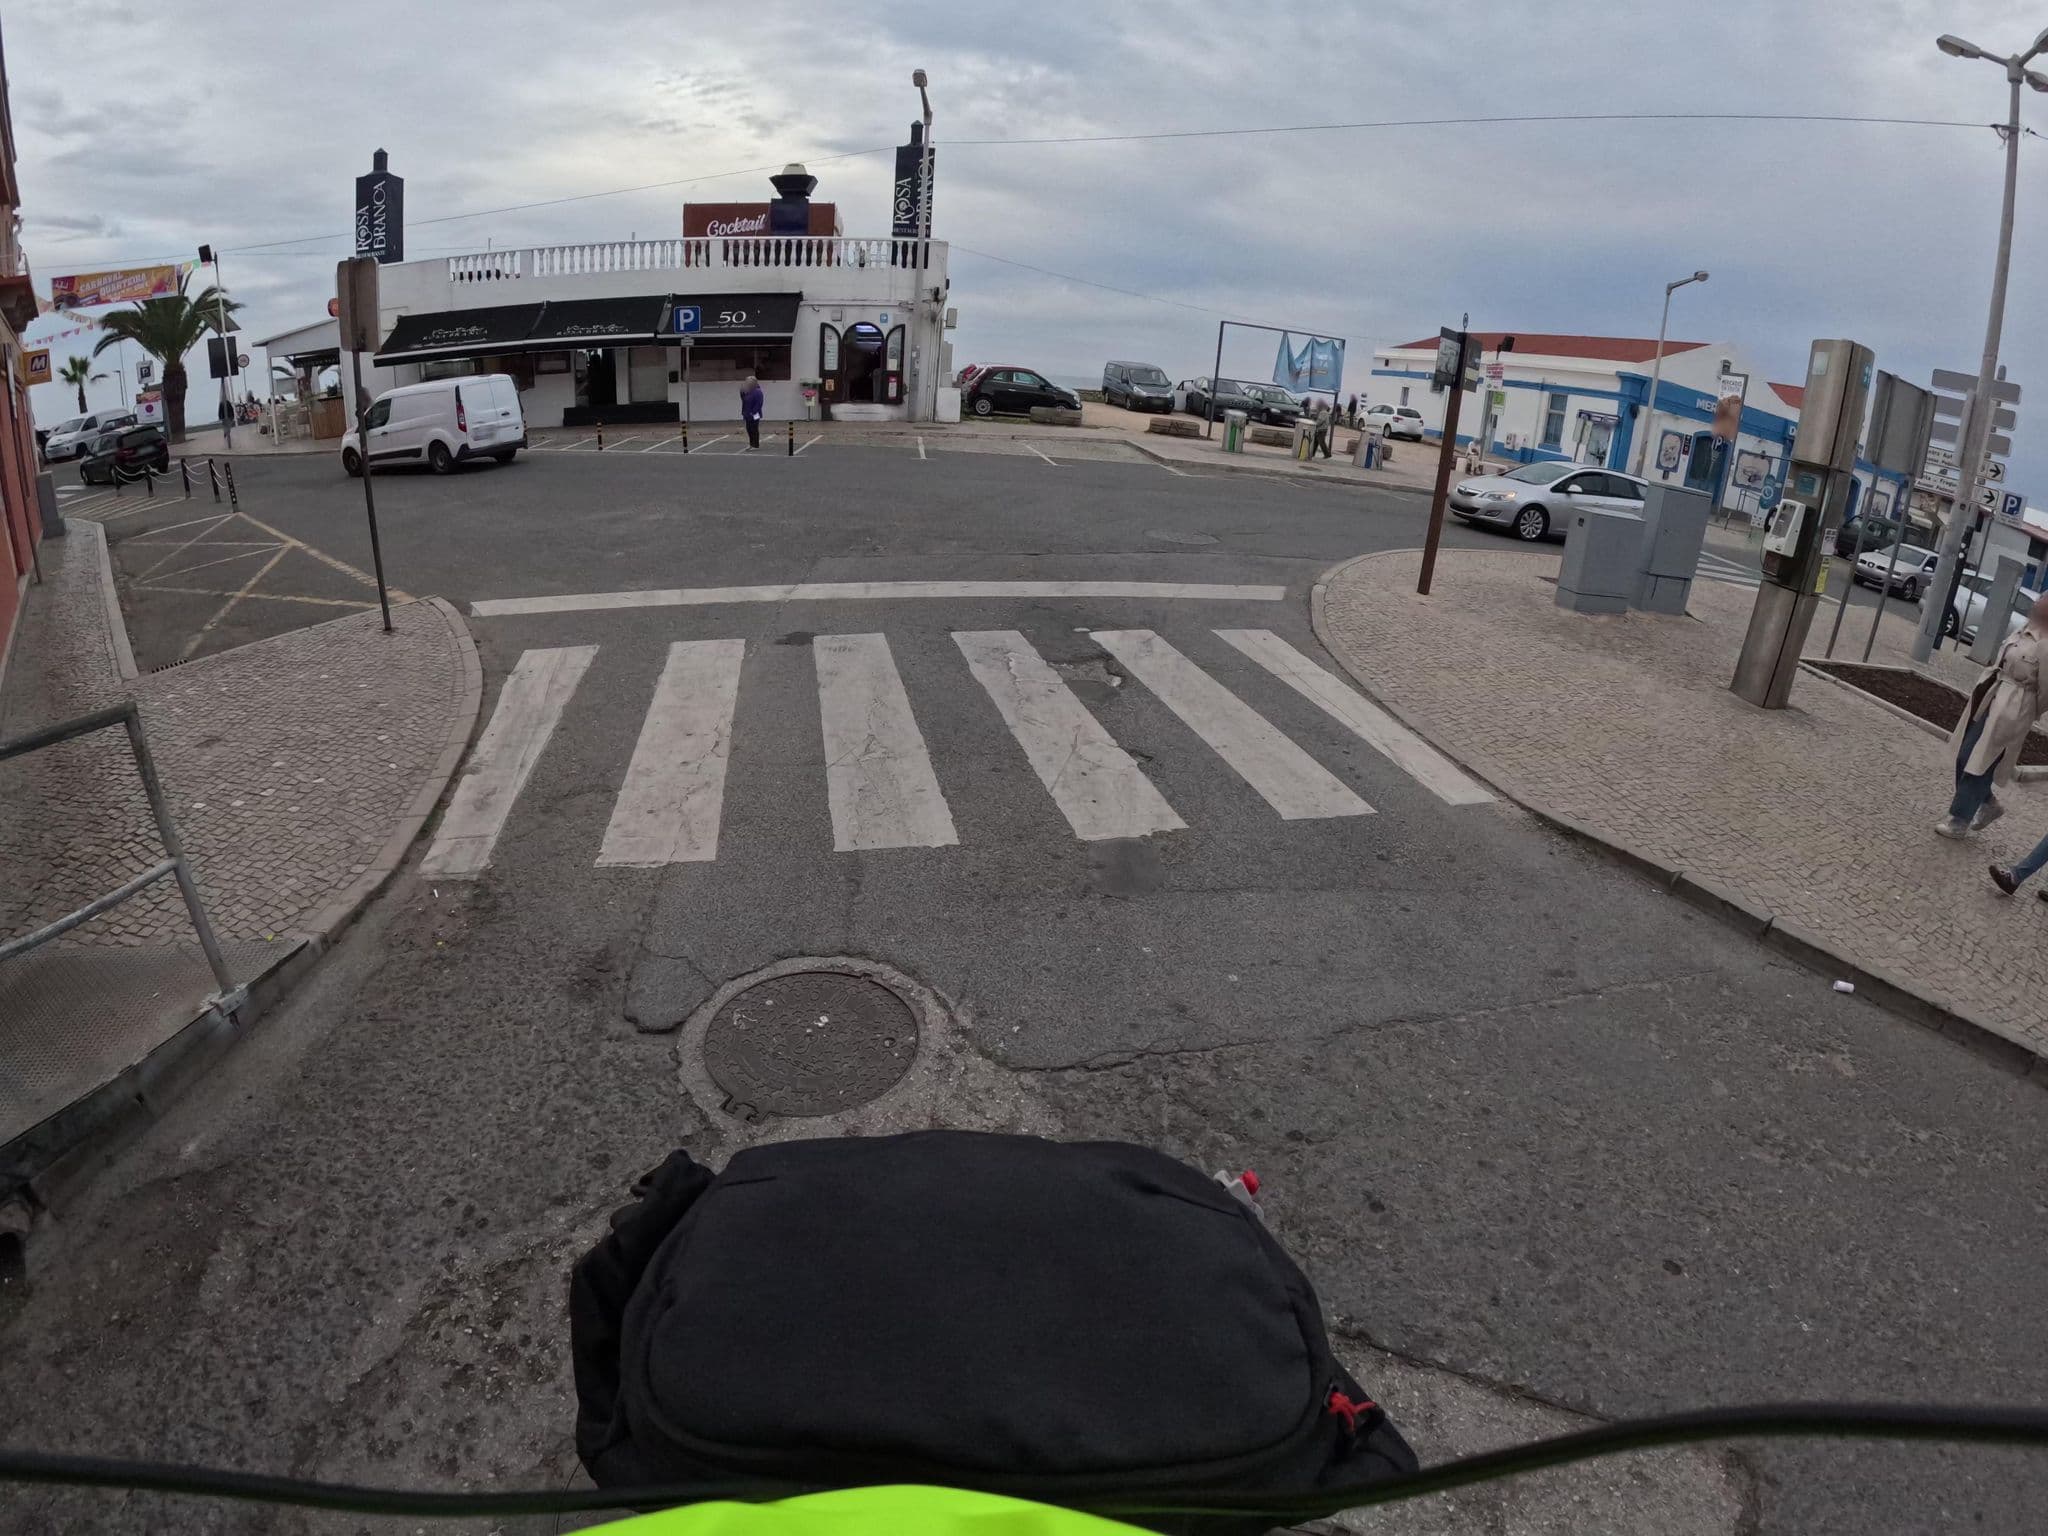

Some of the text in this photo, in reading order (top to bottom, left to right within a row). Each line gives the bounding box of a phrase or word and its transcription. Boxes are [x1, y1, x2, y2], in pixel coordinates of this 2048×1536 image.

[894, 178, 915, 224] ROSA
[373, 180, 386, 248] BRANCA
[707, 213, 765, 236] Cocktail
[357, 205, 373, 251] ROSA
[680, 309, 694, 330] P
[718, 311, 747, 324] 50
[2006, 496, 2017, 512] P
